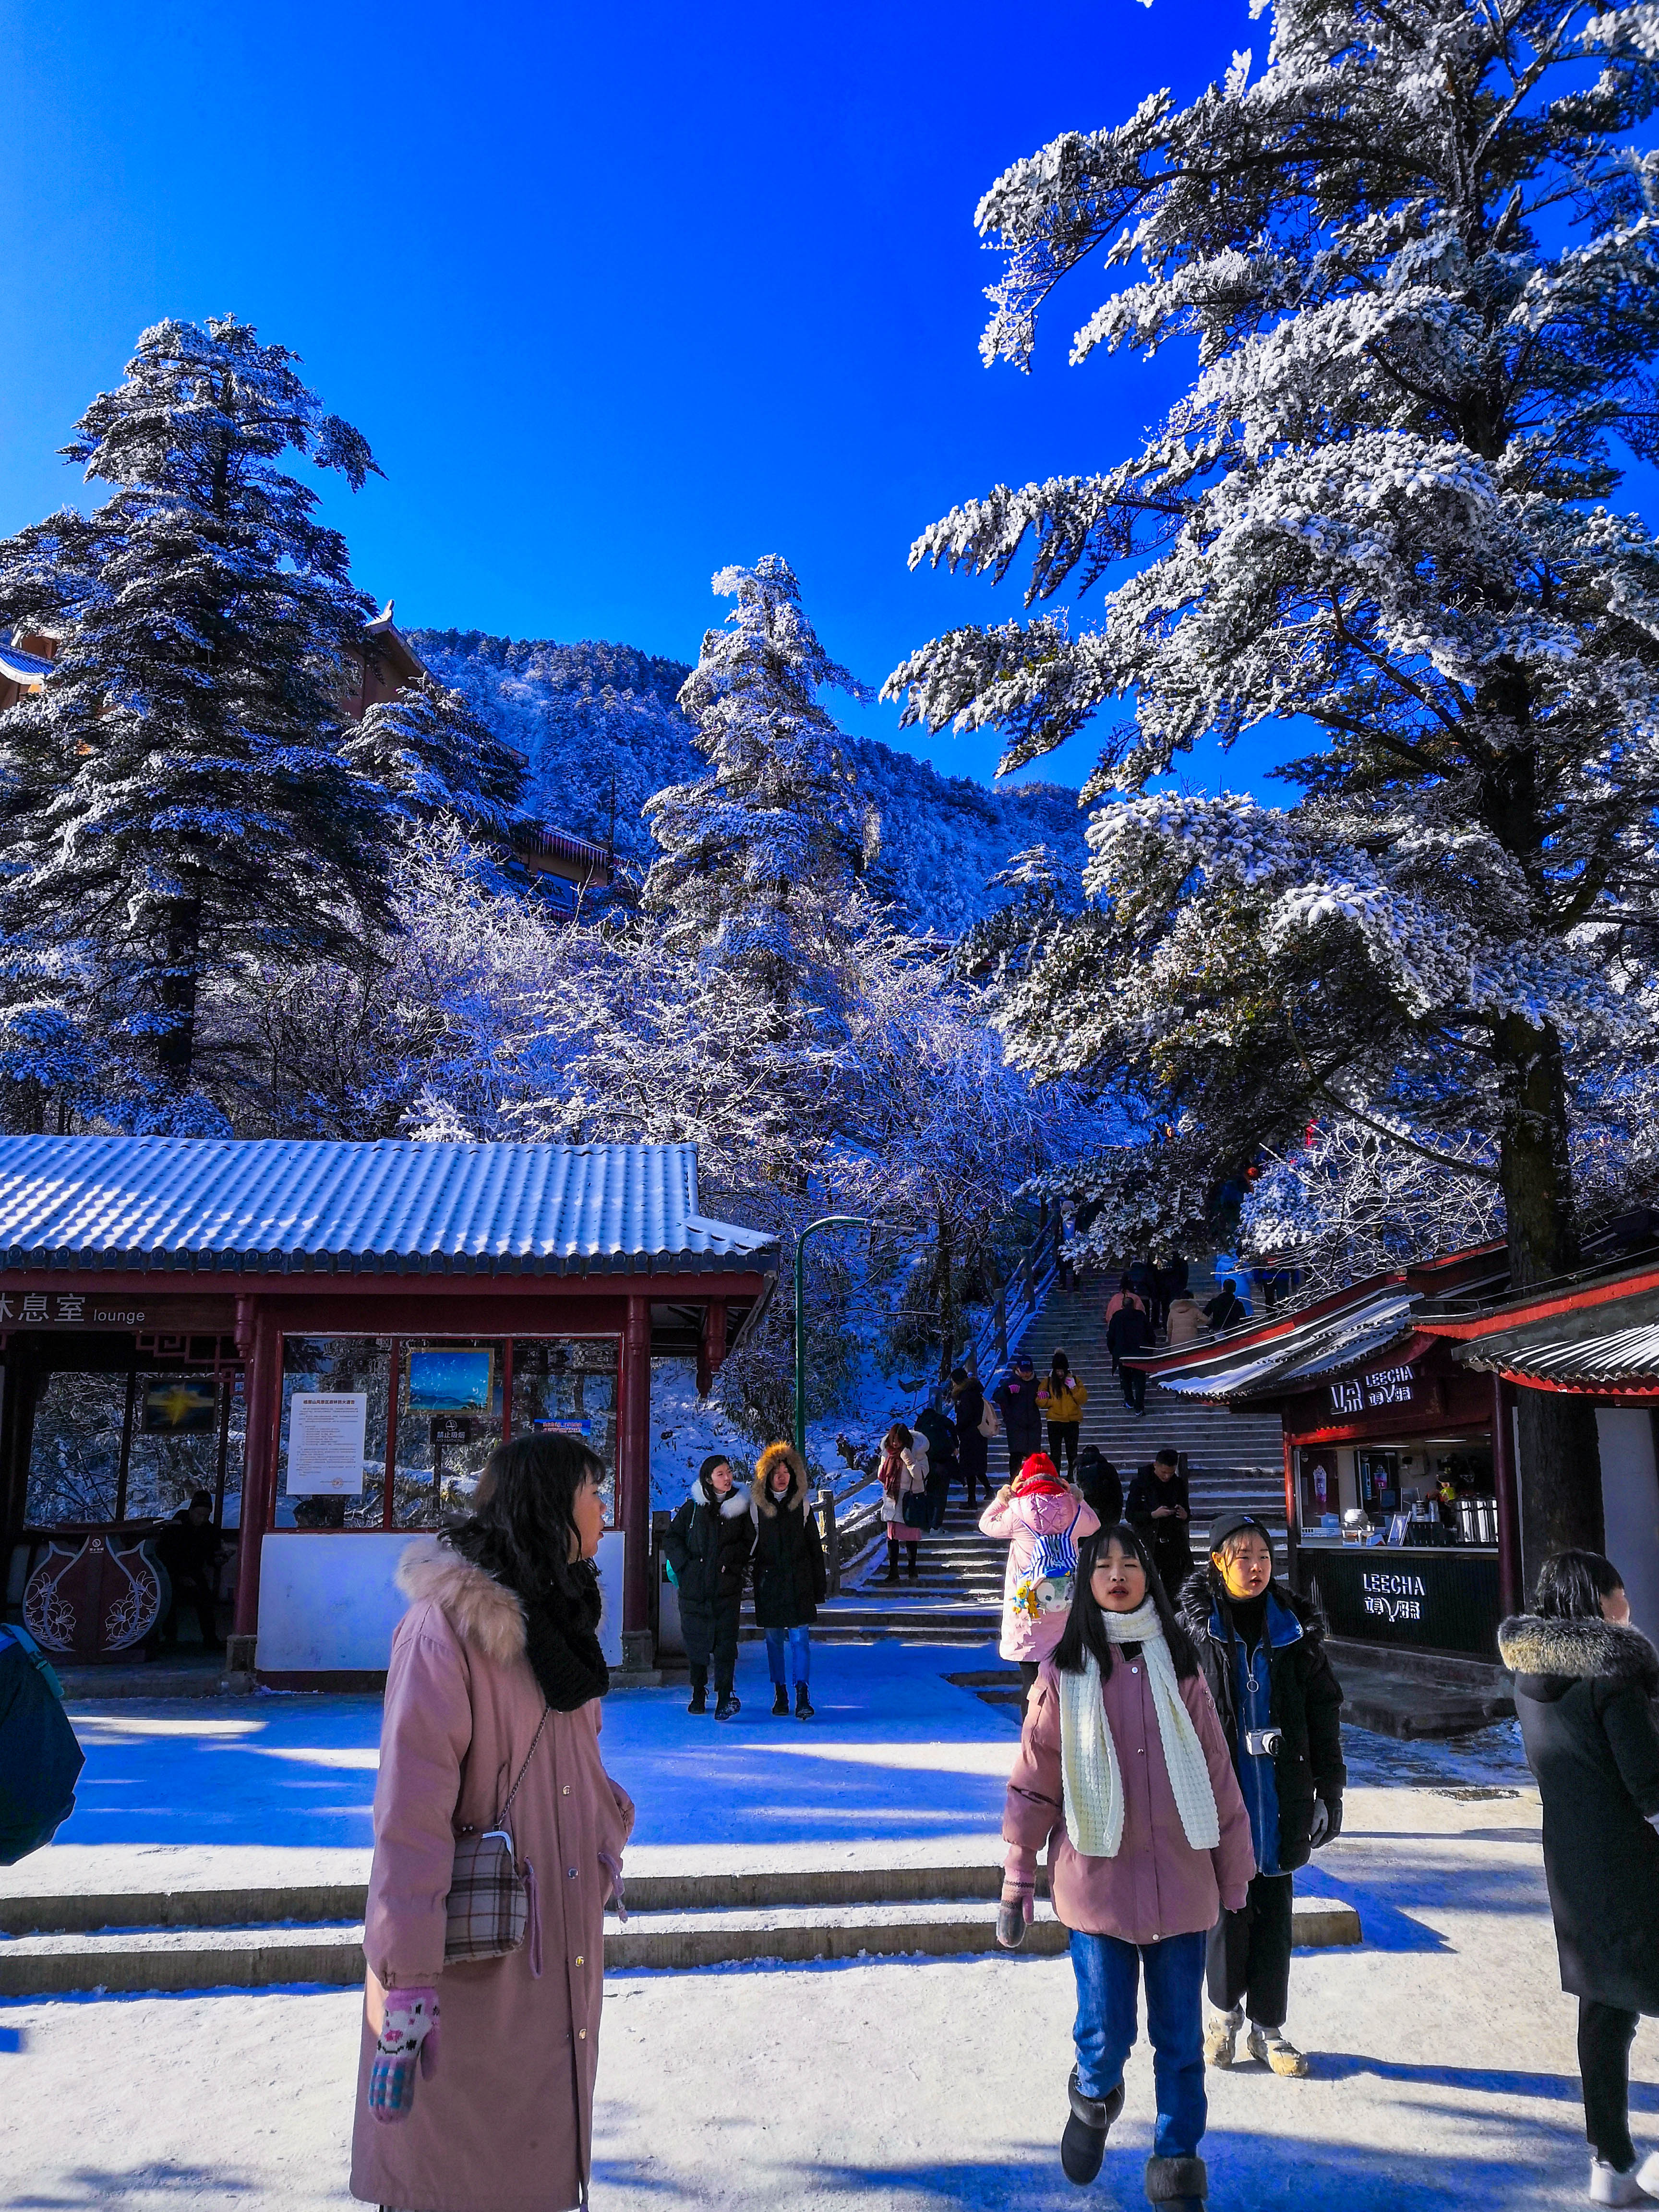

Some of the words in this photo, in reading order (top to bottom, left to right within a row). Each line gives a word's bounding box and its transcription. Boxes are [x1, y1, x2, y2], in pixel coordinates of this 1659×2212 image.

[94, 1309, 145, 1324] lounge
[1365, 1366, 1414, 1387] LEECHA
[1363, 1574, 1425, 1596] LEECHA
